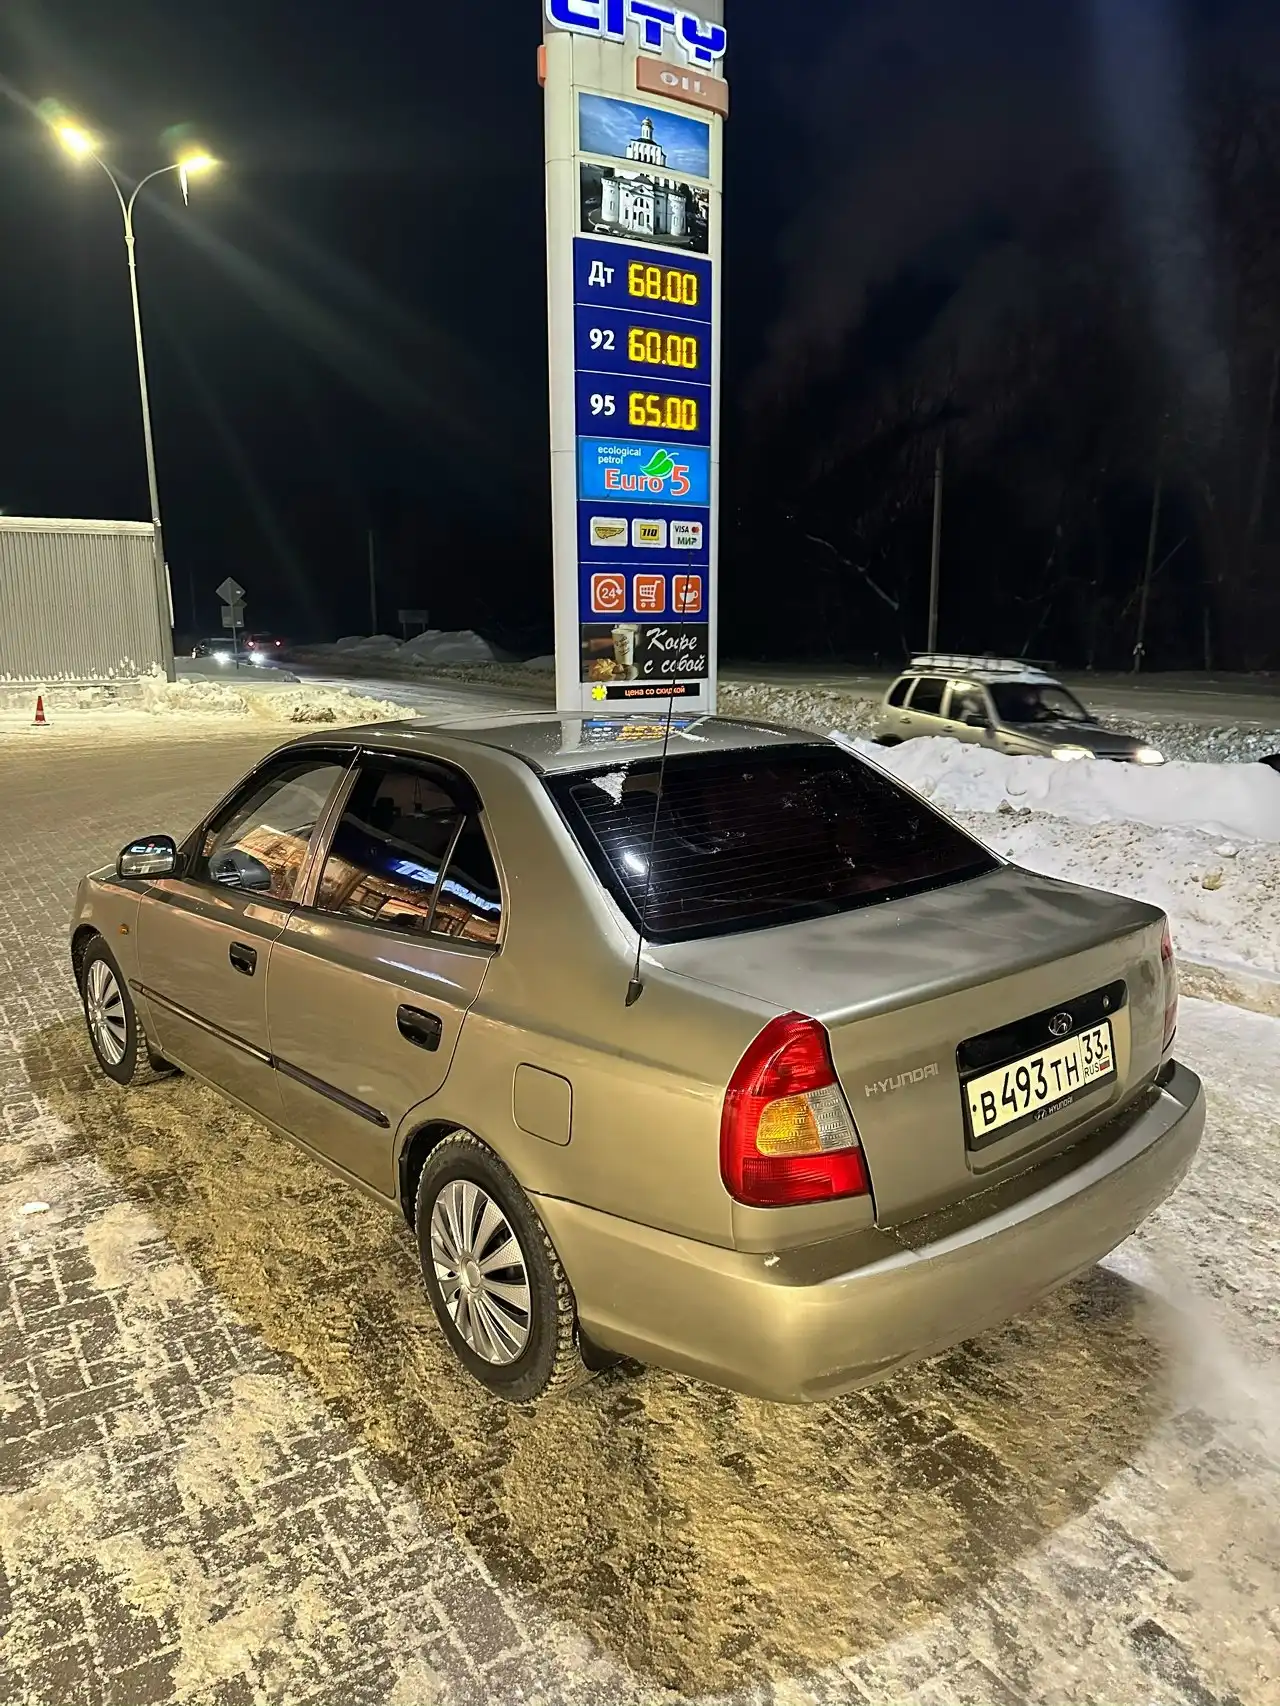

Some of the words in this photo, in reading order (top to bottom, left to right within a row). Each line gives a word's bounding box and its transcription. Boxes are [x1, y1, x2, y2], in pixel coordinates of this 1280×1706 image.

[660, 71, 707, 96] OIL
[588, 261, 615, 287] Дт
[628, 263, 698, 306] 68.00
[589, 328, 615, 350] 92
[628, 329, 697, 369] 60.00
[590, 393, 616, 416] 95
[628, 392, 698, 431] 65.00
[597, 446, 642, 457] ecological
[597, 455, 624, 465] petrol
[604, 468, 664, 493] Euro
[670, 465, 691, 496] 5
[674, 525, 690, 534] VISA
[677, 537, 698, 546] МИР
[601, 588, 616, 599] 24
[646, 627, 698, 651] Кофе
[643, 659, 654, 674] с
[661, 653, 706, 673] собой
[624, 689, 644, 697] цена
[864, 1062, 940, 1097] HYUNDAI
[1084, 1062, 1100, 1078] RUS
[1048, 1095, 1074, 1114] HYUNDAI
